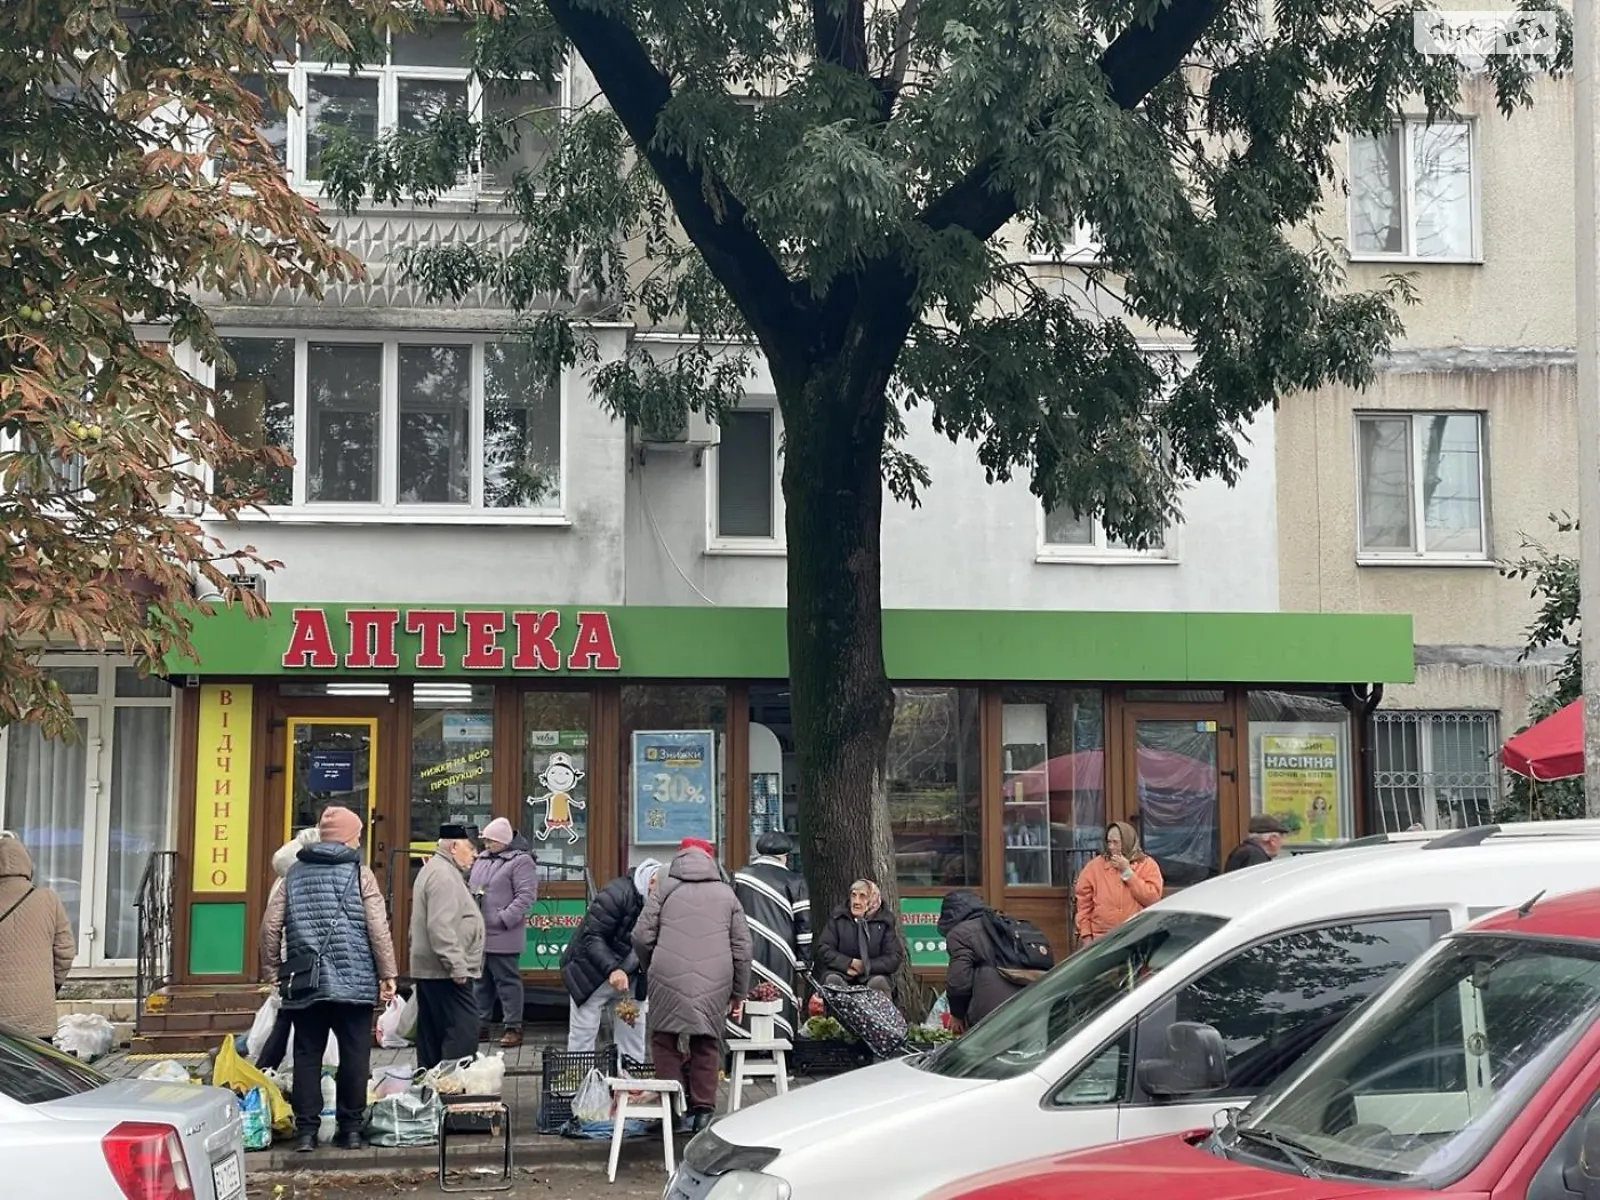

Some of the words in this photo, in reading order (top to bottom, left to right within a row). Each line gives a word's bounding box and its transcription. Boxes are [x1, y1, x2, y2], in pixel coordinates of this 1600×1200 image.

[282, 609, 621, 671] АПТЕКА
[1266, 755, 1334, 769] НАСІННЯ
[211, 689, 233, 887] ВІДЧИНЕНО
[642, 772, 706, 804] -30%
